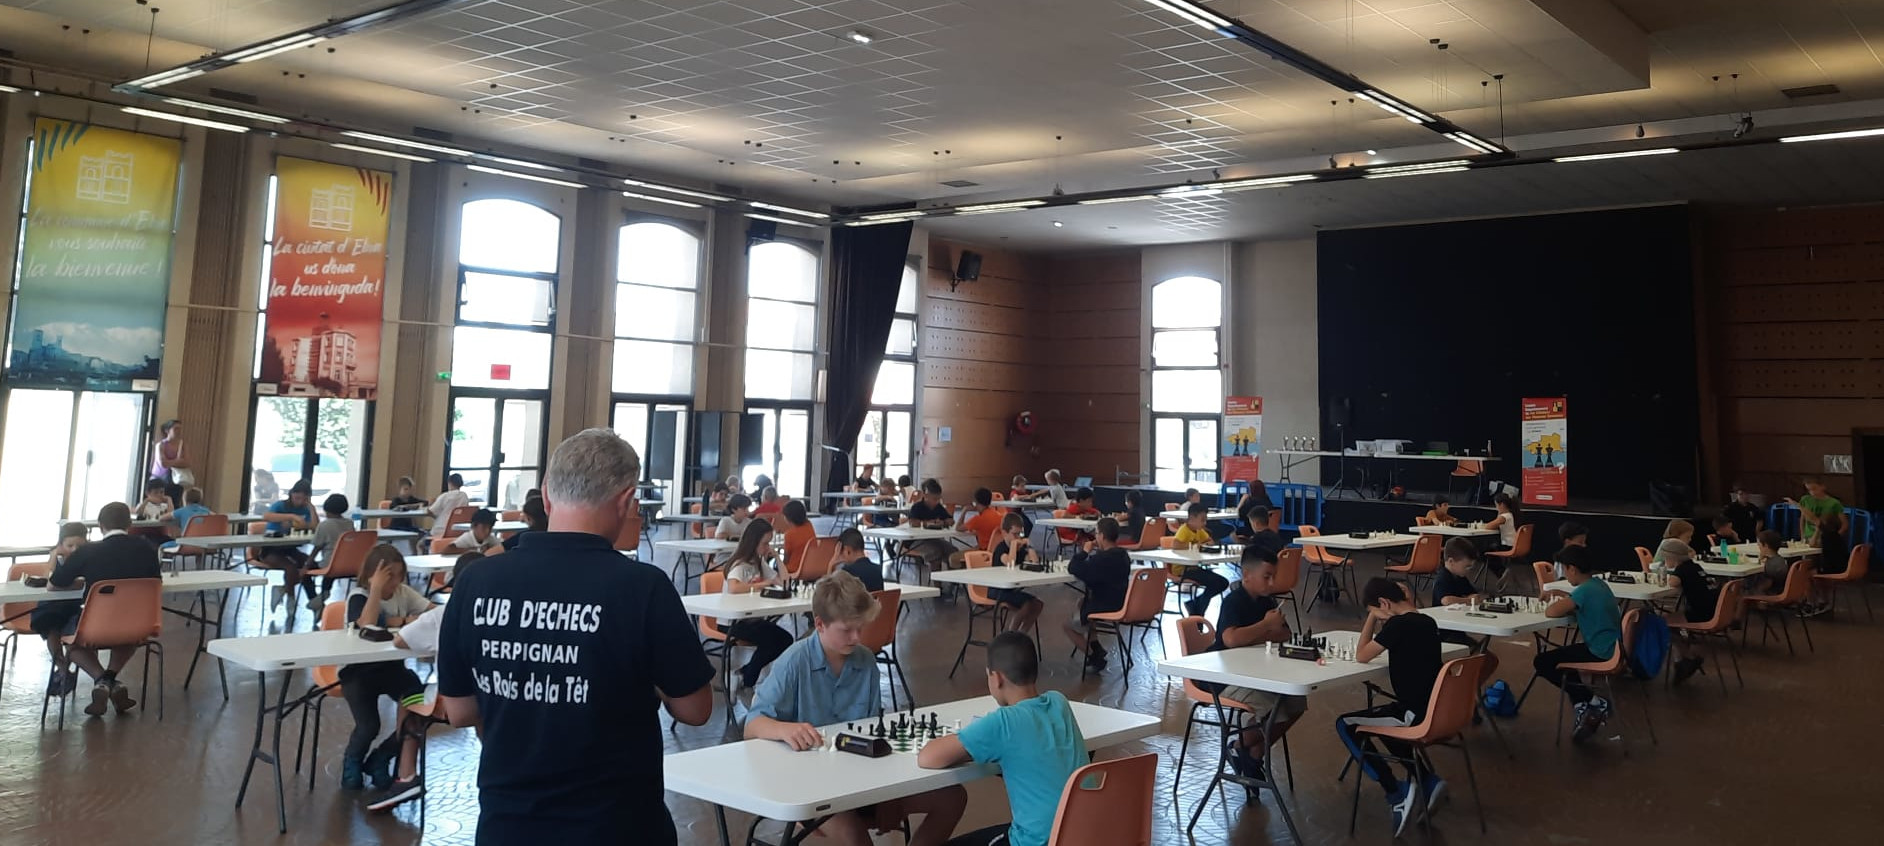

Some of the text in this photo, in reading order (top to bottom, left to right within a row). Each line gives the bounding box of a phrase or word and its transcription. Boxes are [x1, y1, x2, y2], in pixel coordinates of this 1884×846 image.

[49, 237, 81, 251] vous
[272, 236, 292, 257] La
[295, 240, 336, 255] ciutat
[25, 254, 48, 279] la
[54, 253, 151, 279] bienvenue
[304, 263, 319, 275] us
[270, 277, 288, 298] la
[473, 597, 602, 633] CLUB D'ECHECS
[481, 639, 580, 664] PERPIGNAN
[492, 670, 519, 700] Rois
[523, 672, 543, 702] de
[544, 674, 561, 704] la
[565, 675, 590, 704] Têt
